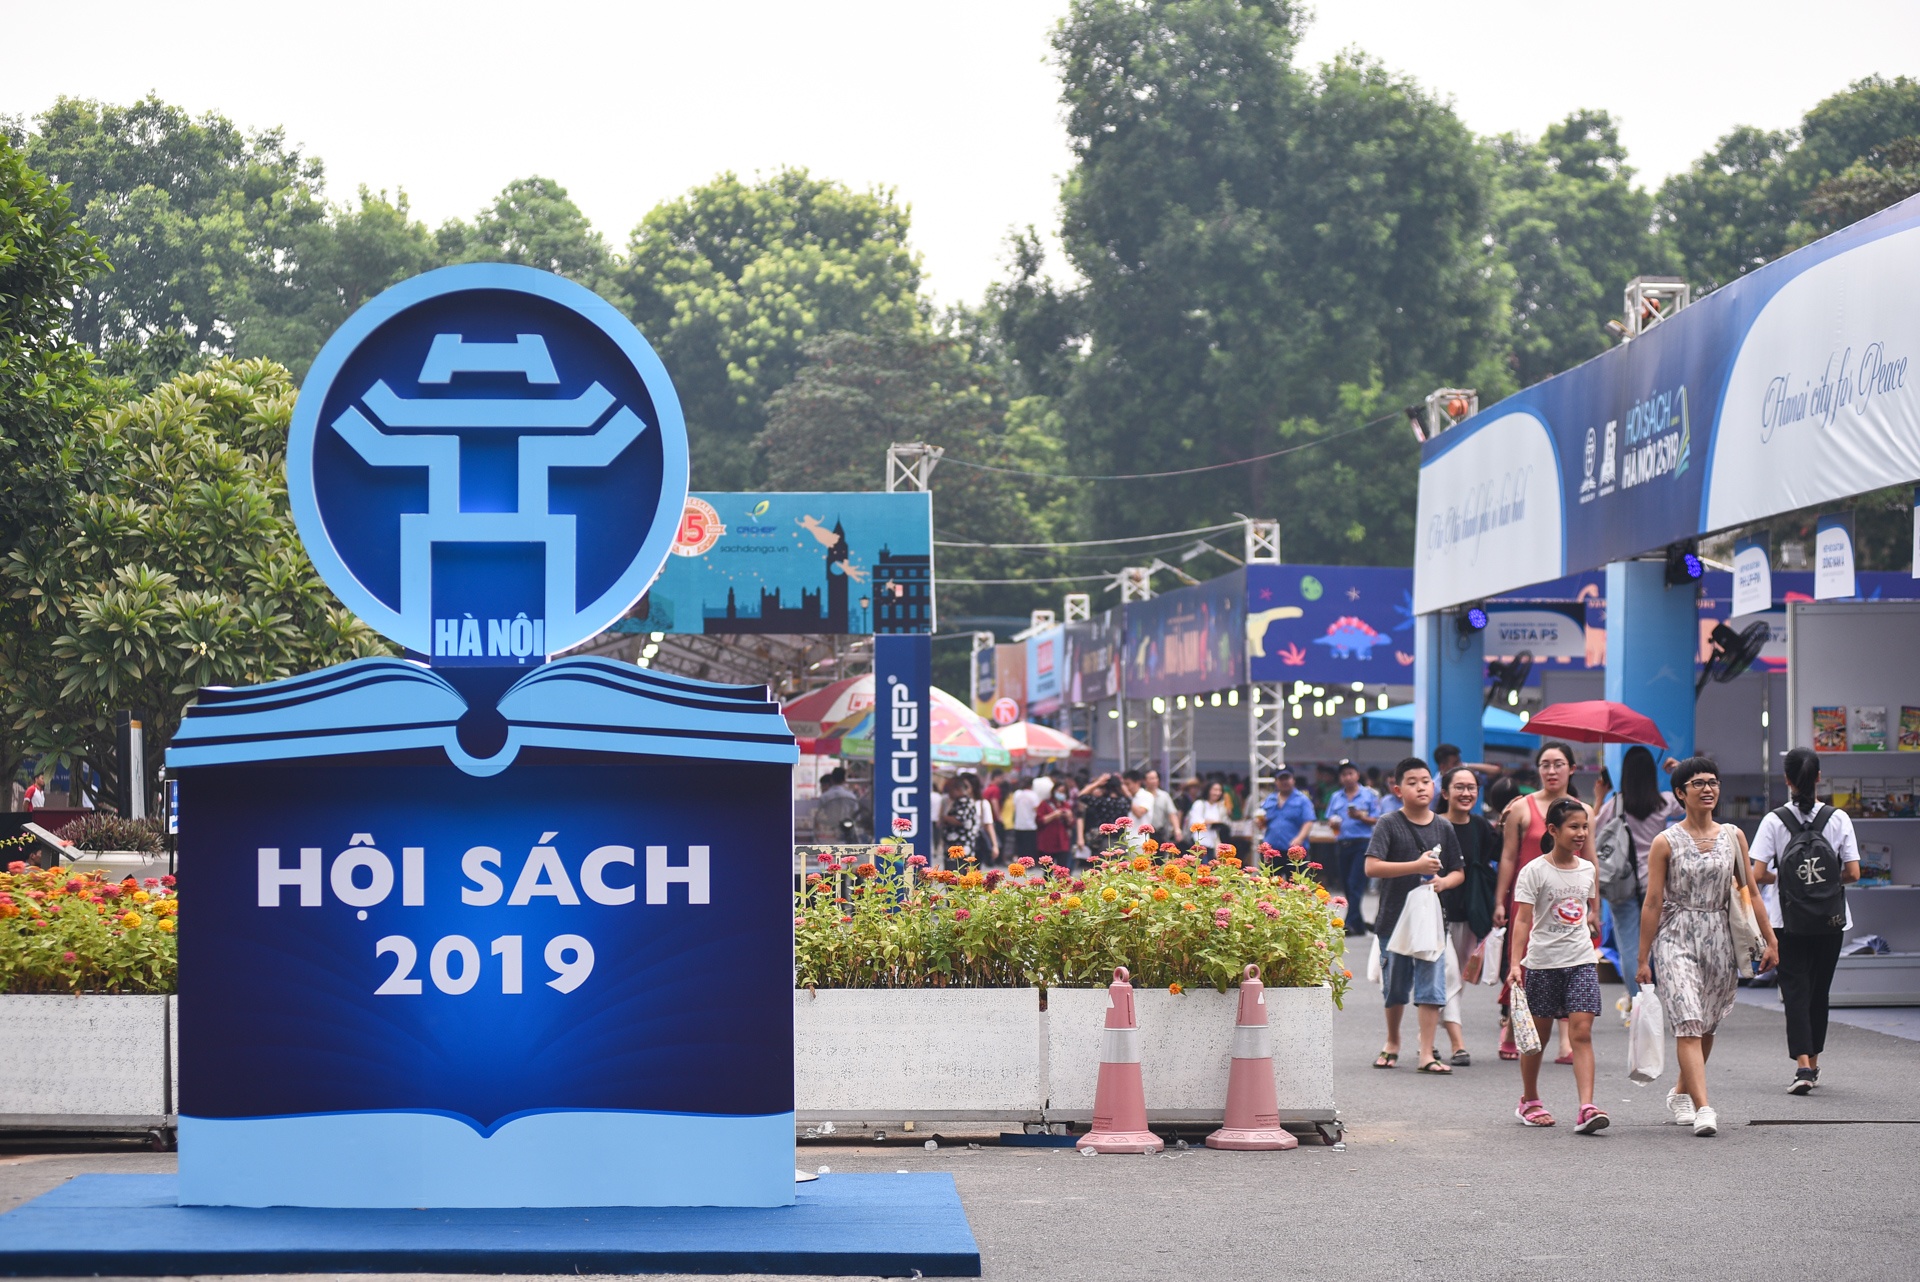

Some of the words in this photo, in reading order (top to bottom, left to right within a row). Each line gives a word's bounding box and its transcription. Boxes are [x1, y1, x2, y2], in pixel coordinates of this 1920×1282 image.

[1856, 341, 1908, 416] Peace
[720, 545, 789, 554] sachdonga.vn
[435, 612, 483, 656] HÀ
[488, 612, 544, 664] NỘI
[1500, 630, 1537, 641] VISTA
[1541, 630, 1559, 641] PS
[1877, 741, 1884, 750] 2
[258, 833, 424, 921] HỘI
[461, 831, 710, 906] SÁCH
[374, 934, 595, 995] 2019
